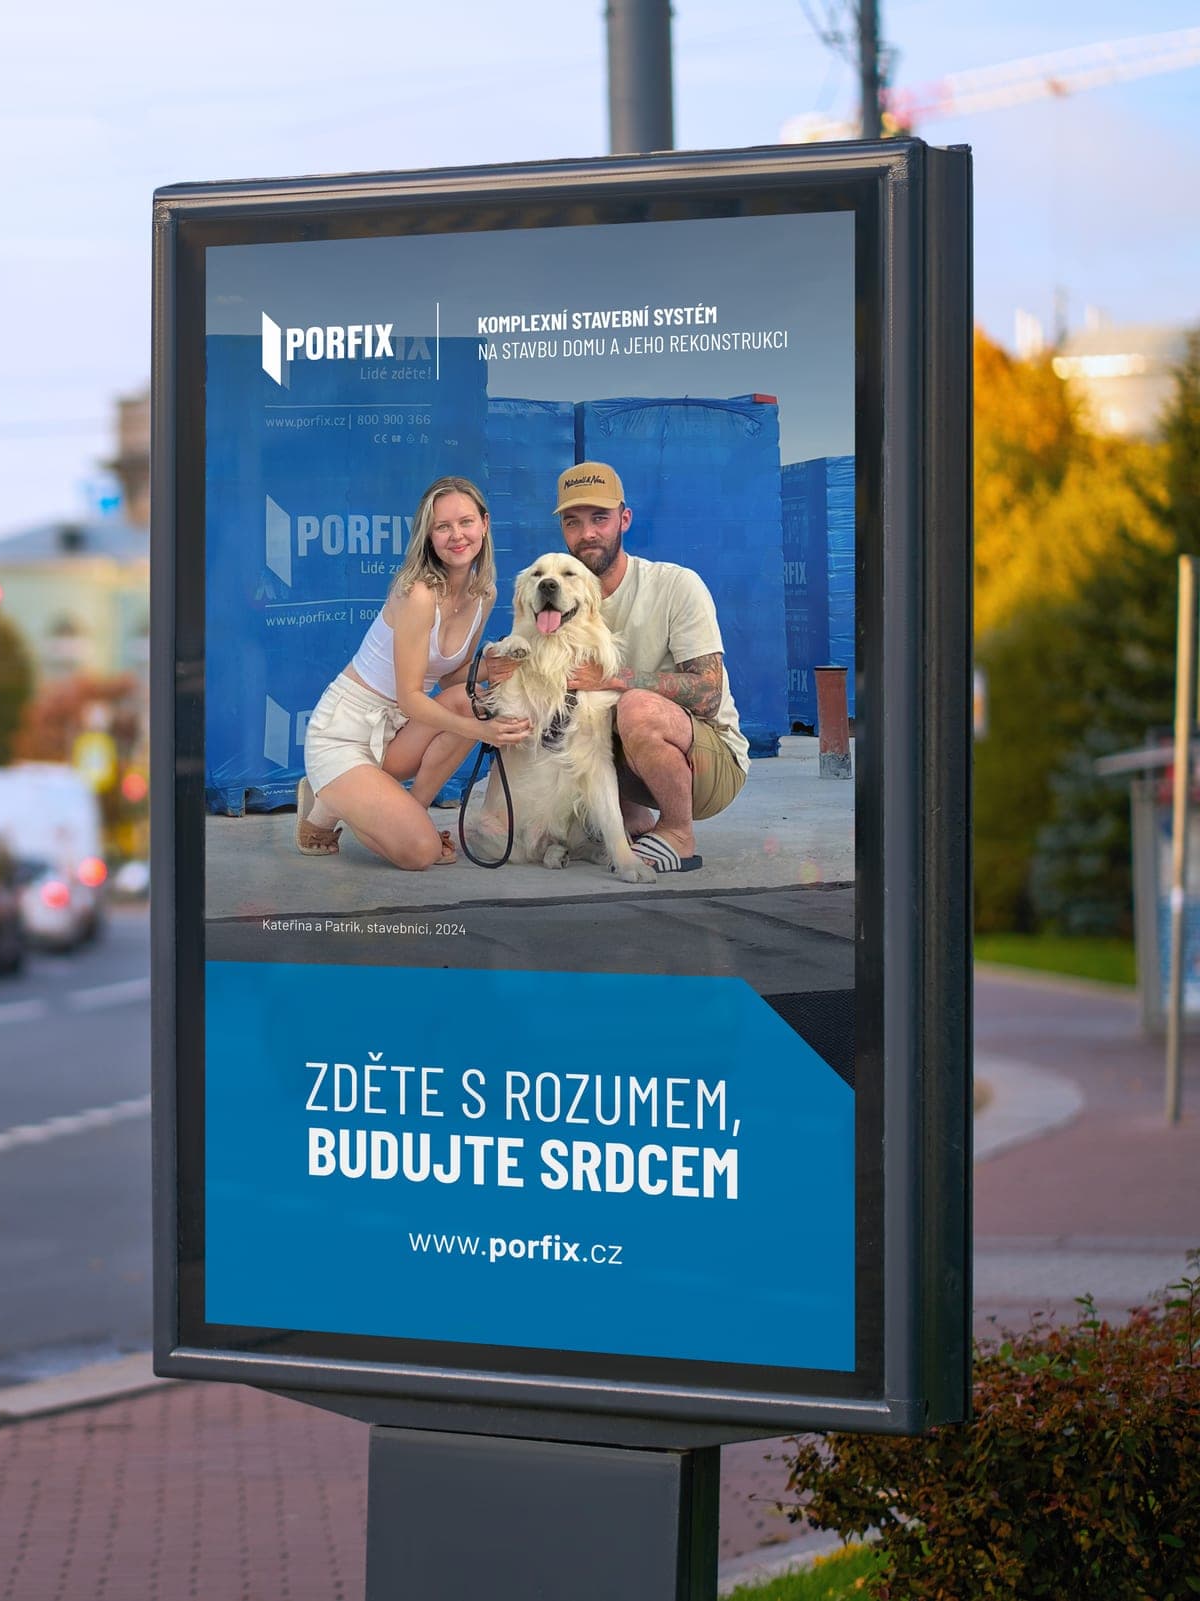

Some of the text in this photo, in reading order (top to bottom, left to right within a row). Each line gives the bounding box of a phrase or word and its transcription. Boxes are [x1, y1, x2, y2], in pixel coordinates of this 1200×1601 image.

[478, 303, 717, 333] KOMPLEXNÍ STAVEBNÍ SYSTÉM
[286, 324, 394, 361] PORFIX
[478, 330, 788, 360] NA STAVBU DOMU A JEHO REKONSTRUKCI
[360, 367, 388, 380] Lidé
[265, 414, 431, 429] www.porfix.cz 800 900 366
[360, 561, 385, 574] Lidé
[266, 611, 346, 627] www.porfix.cz
[262, 919, 312, 932] Kateřina
[314, 923, 322, 932] a
[325, 921, 364, 934] Patrik,
[435, 924, 466, 935] 2024
[305, 1052, 741, 1137] ZDĚTE S ROZUMEM,
[308, 1127, 739, 1200] BUDUJTE SRDCEM
[408, 1232, 623, 1265] www.porfix.cz
